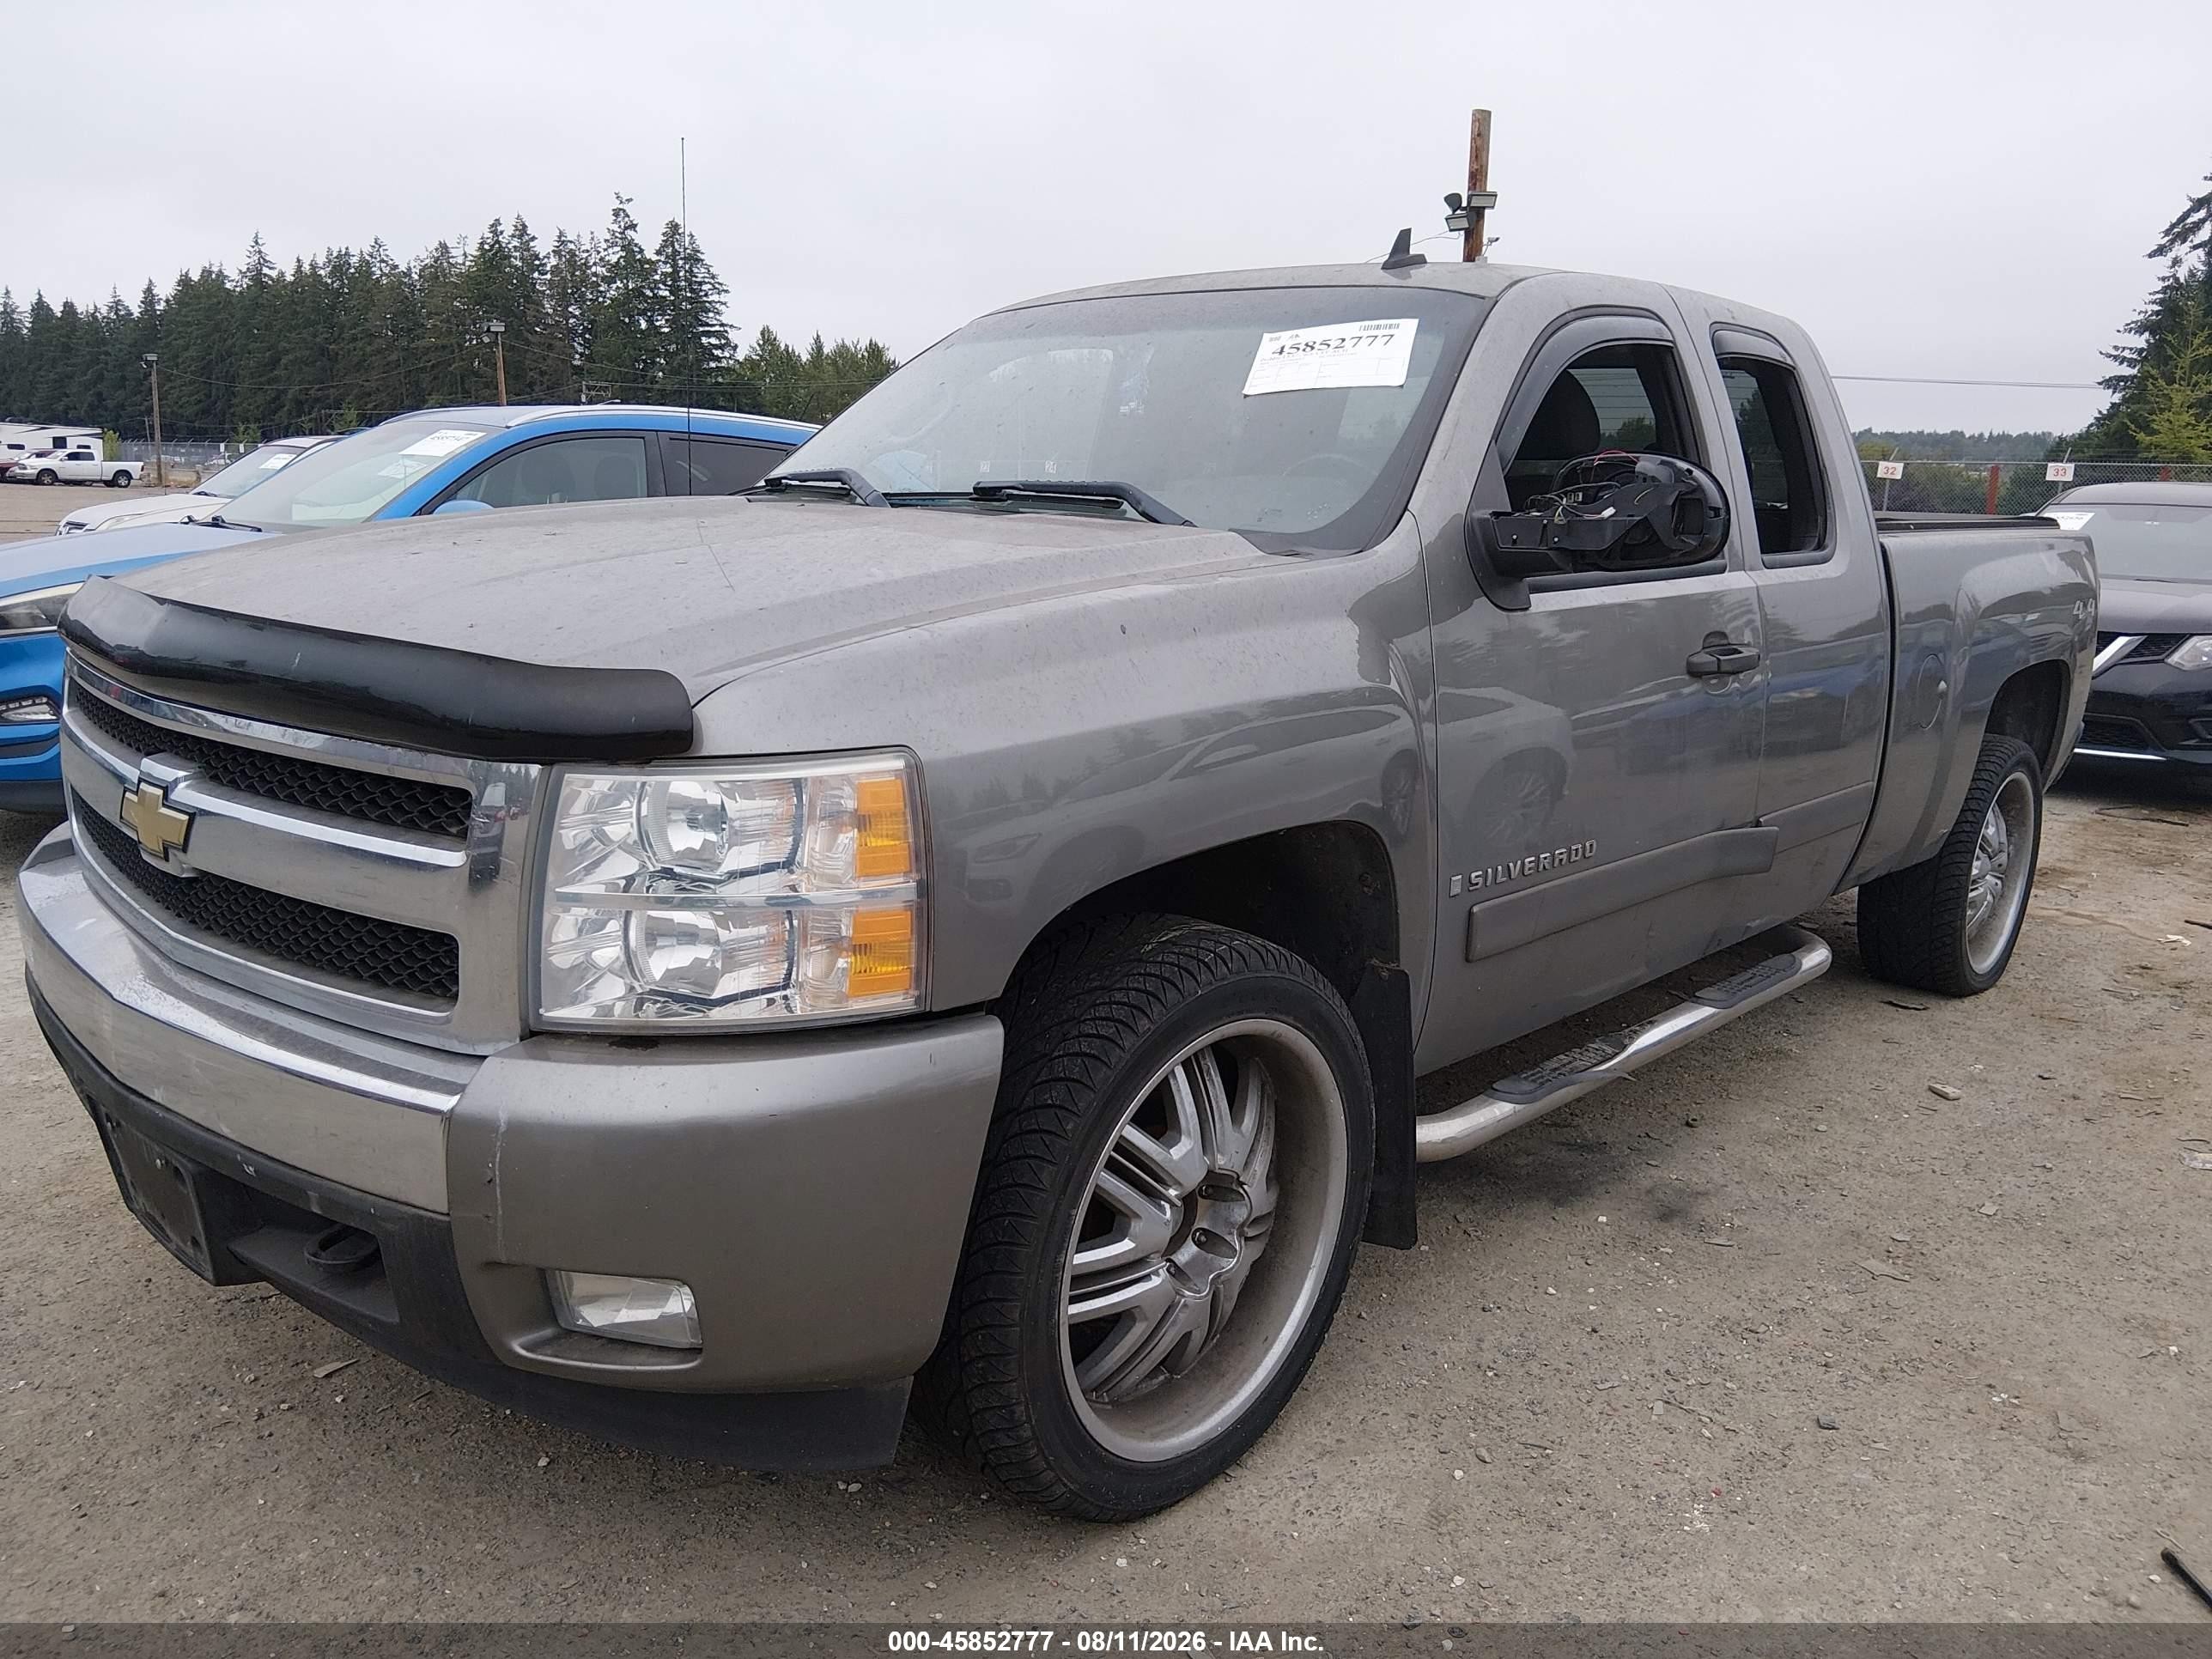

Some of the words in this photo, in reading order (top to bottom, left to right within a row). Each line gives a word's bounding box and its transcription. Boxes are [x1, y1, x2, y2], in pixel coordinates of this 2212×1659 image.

[1271, 333, 1395, 356] 45852777
[1883, 465, 1897, 476] 32
[2053, 467, 2067, 477] 33
[1468, 839, 1596, 891] SILVERADO
